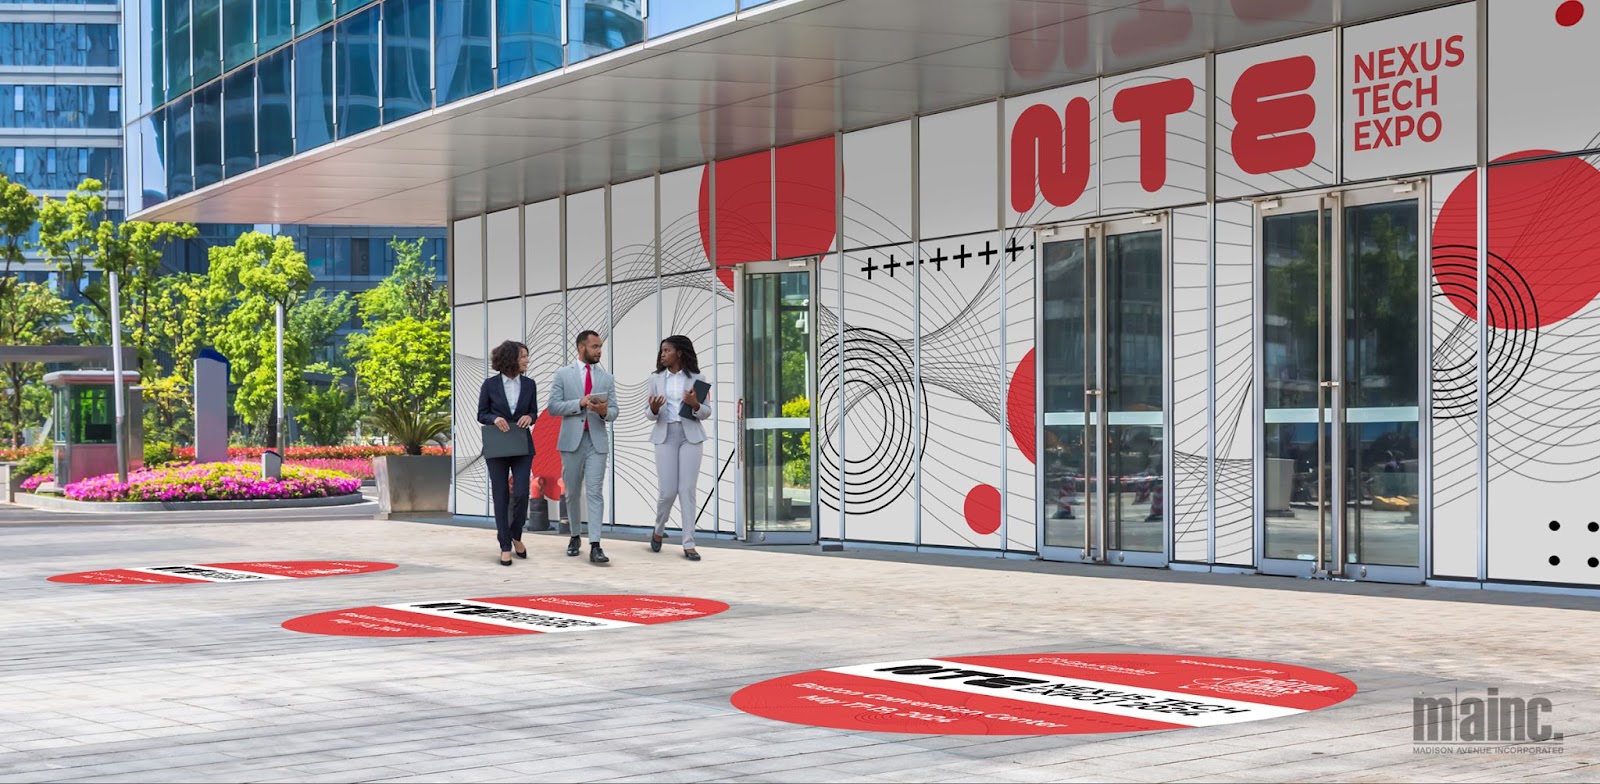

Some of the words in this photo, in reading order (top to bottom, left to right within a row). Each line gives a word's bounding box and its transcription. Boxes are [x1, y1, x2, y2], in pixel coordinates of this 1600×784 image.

[1354, 35, 1465, 83] NEXUS
[1352, 75, 1439, 116] TECH
[1011, 55, 1316, 213] NTE
[1354, 111, 1443, 151] EXPO
[874, 665, 1050, 689] NTE
[791, 682, 865, 696] Boston
[863, 694, 985, 716] Convention
[984, 713, 1069, 728] Center
[798, 695, 848, 705] May
[895, 711, 959, 723] 2024
[1013, 686, 1104, 701] EXPO
[1115, 702, 1209, 716] 2024
[1040, 684, 1156, 701] NEXUS
[1151, 698, 1251, 714] TECH
